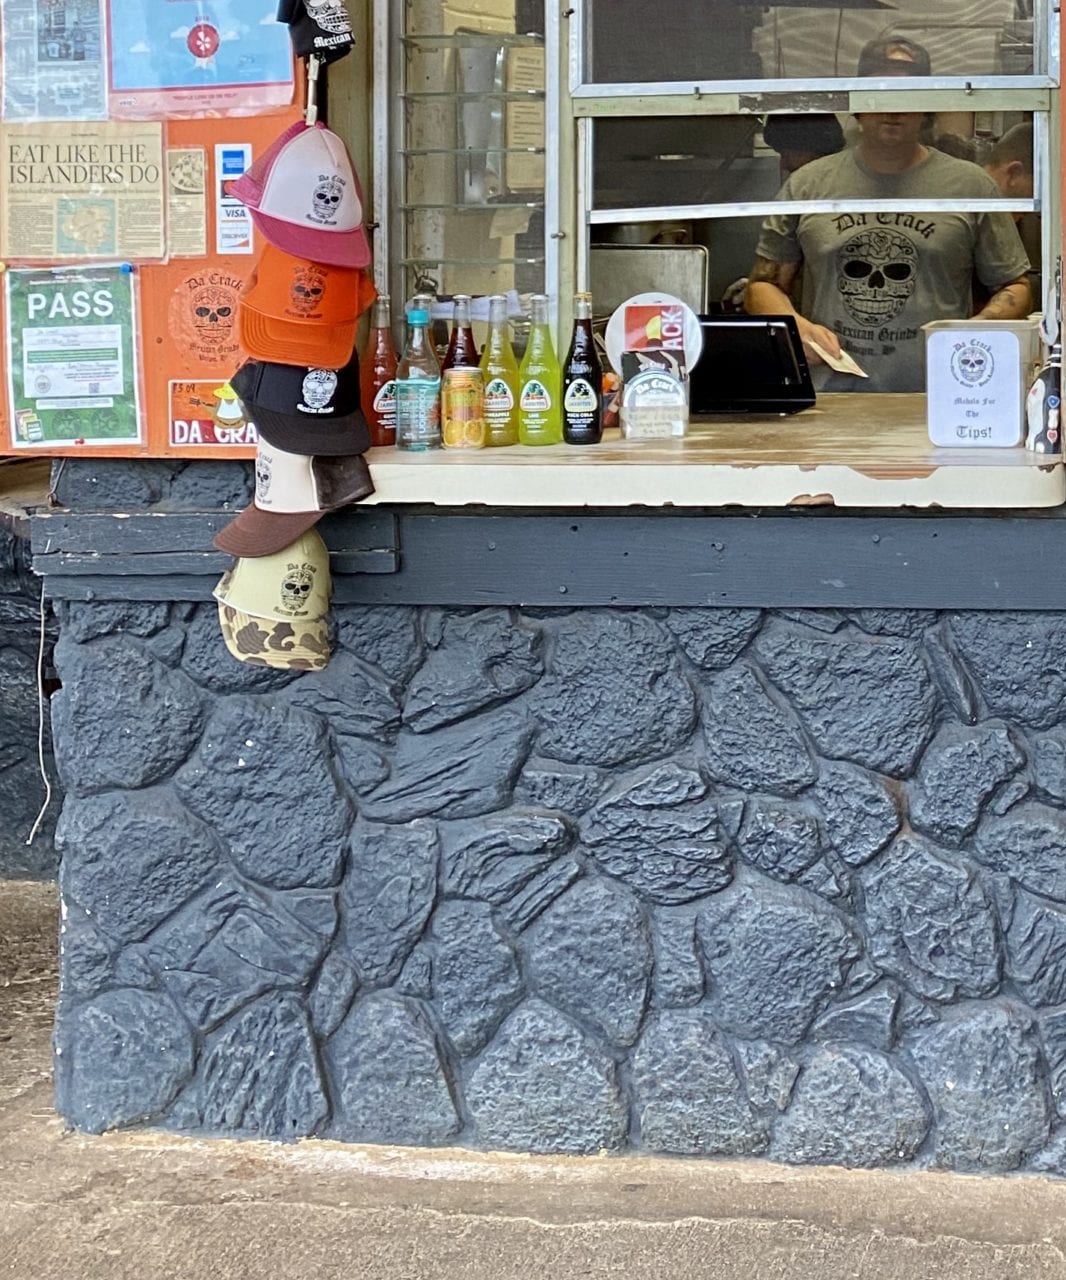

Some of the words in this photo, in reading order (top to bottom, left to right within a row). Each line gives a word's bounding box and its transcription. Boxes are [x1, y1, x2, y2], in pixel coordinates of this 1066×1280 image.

[314, 34, 351, 48] Mexican
[9, 145, 49, 163] EAT
[56, 145, 100, 163] LIKE
[105, 145, 146, 163] THE
[9, 165, 124, 183] ISLANDERS
[131, 166, 159, 183] DO
[225, 209, 246, 217] VISA
[832, 212, 867, 235] Da
[876, 212, 937, 240] Crack
[185, 276, 206, 290] Da
[209, 273, 243, 291] Crack
[28, 290, 114, 319] PASS
[175, 421, 202, 443] DA
[956, 425, 992, 439] Tips!
